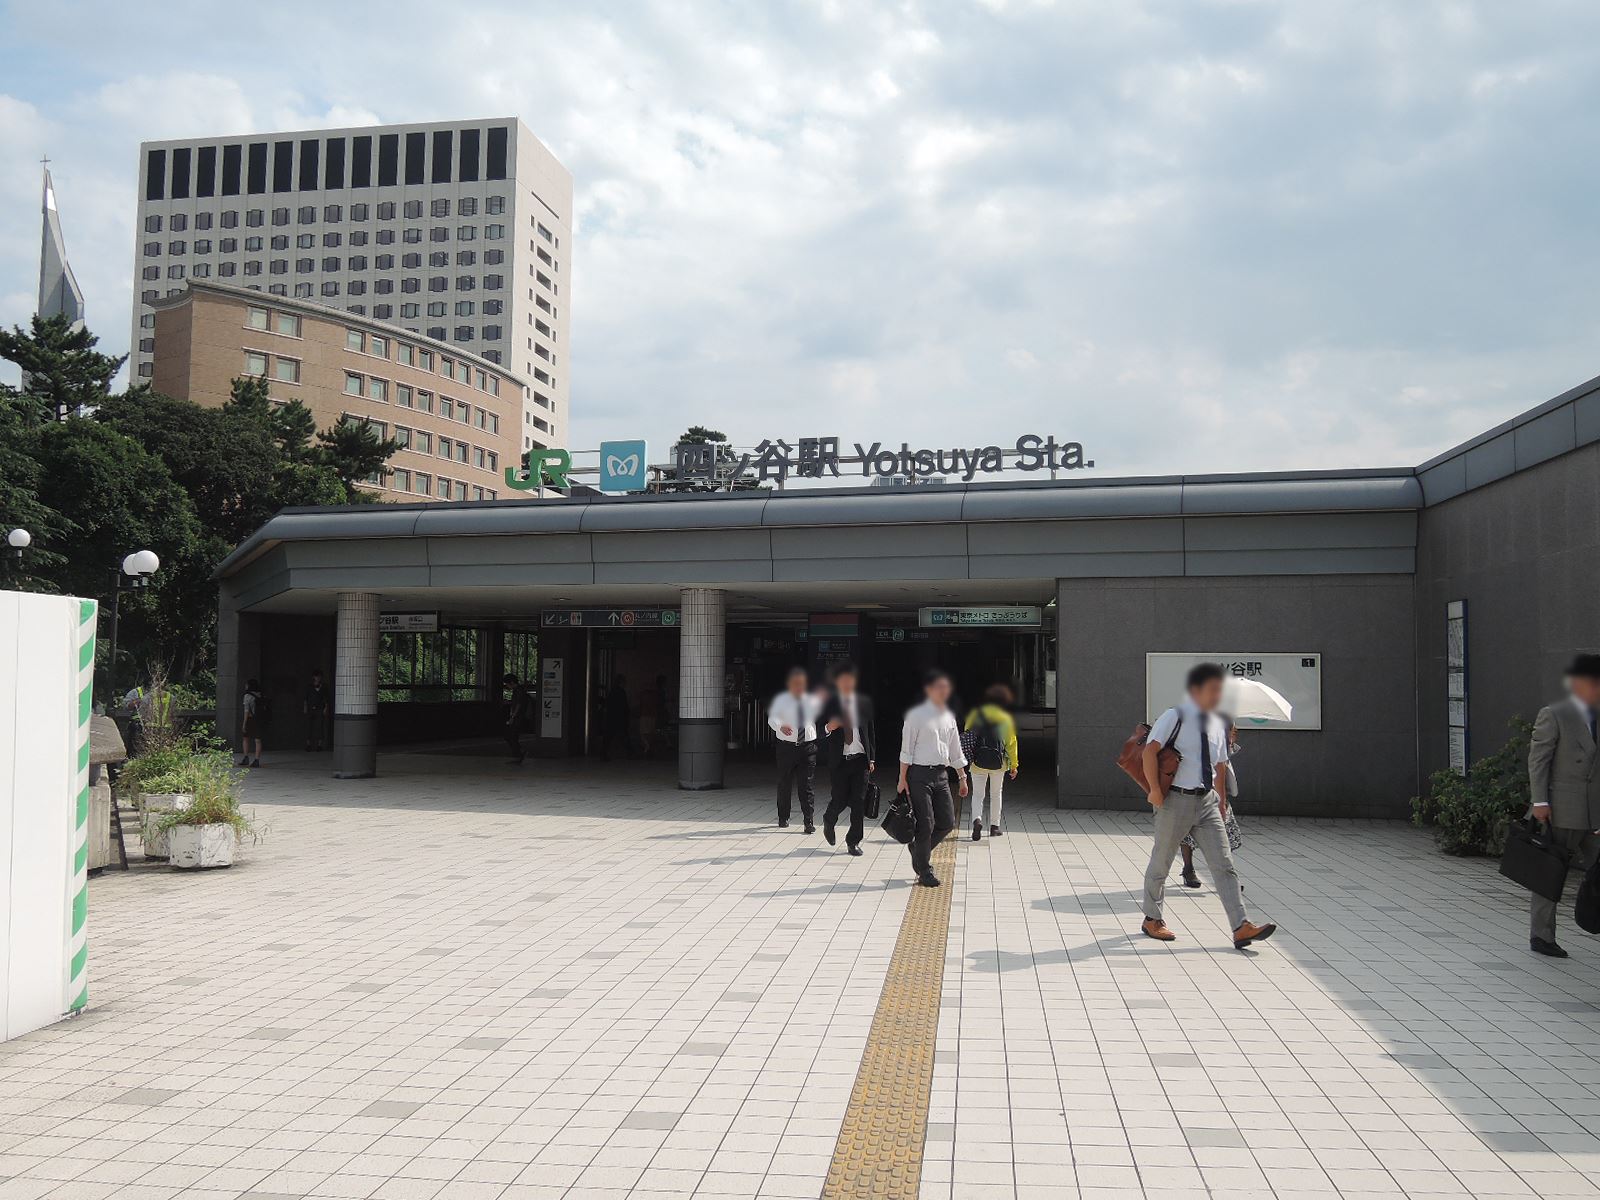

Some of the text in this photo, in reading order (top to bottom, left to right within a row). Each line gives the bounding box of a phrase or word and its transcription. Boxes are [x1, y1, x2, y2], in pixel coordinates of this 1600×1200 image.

[505, 447, 572, 490] JR
[676, 436, 841, 482] 四ツ谷駅
[854, 434, 1095, 482] Yotsuya Sta.
